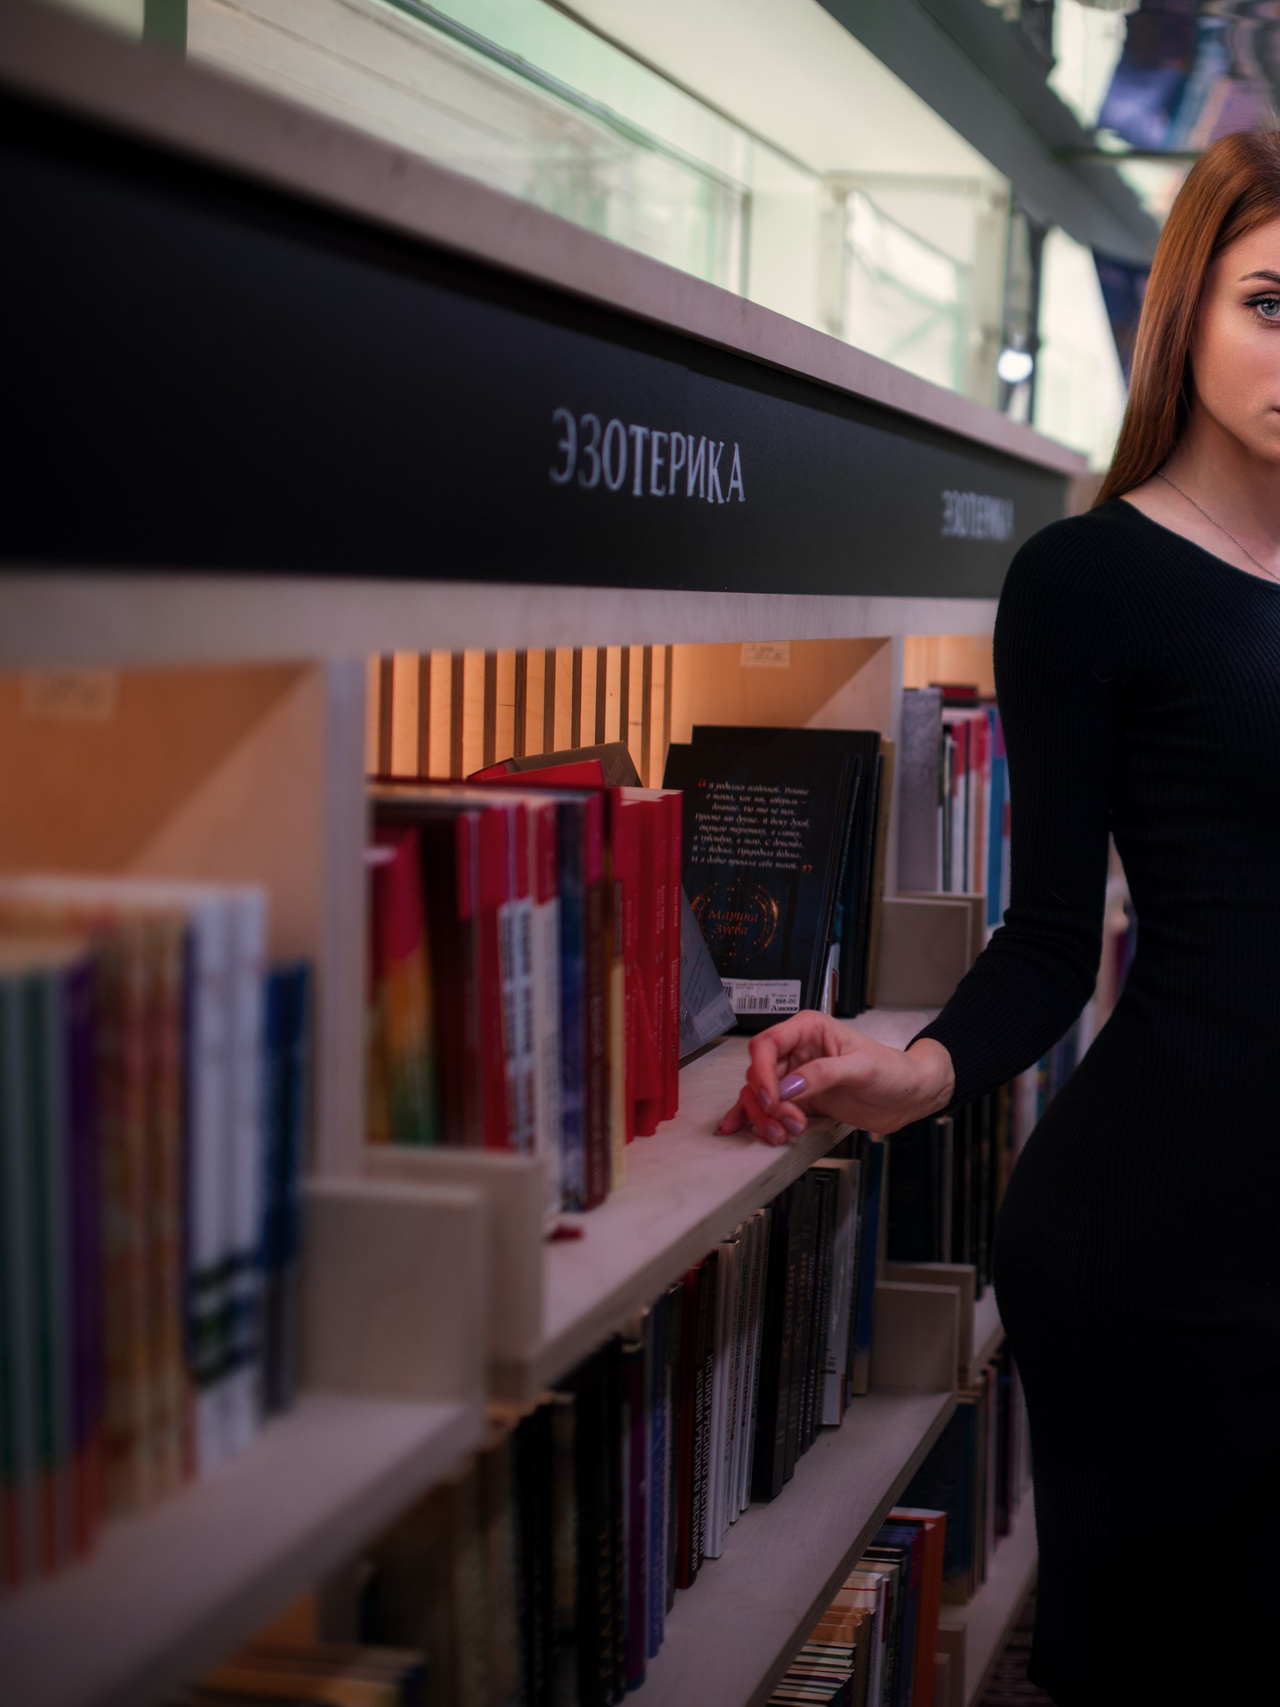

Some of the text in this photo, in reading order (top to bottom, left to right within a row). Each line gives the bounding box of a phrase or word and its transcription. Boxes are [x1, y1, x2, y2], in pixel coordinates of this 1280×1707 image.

[549, 407, 746, 504] ЭЗОТЕРИКА
[941, 489, 1015, 542] ЭЗОТЕРИКА
[708, 909, 759, 923] Марина
[713, 921, 749, 939] Зуева
[694, 1425, 703, 1491] РУССКОГО
